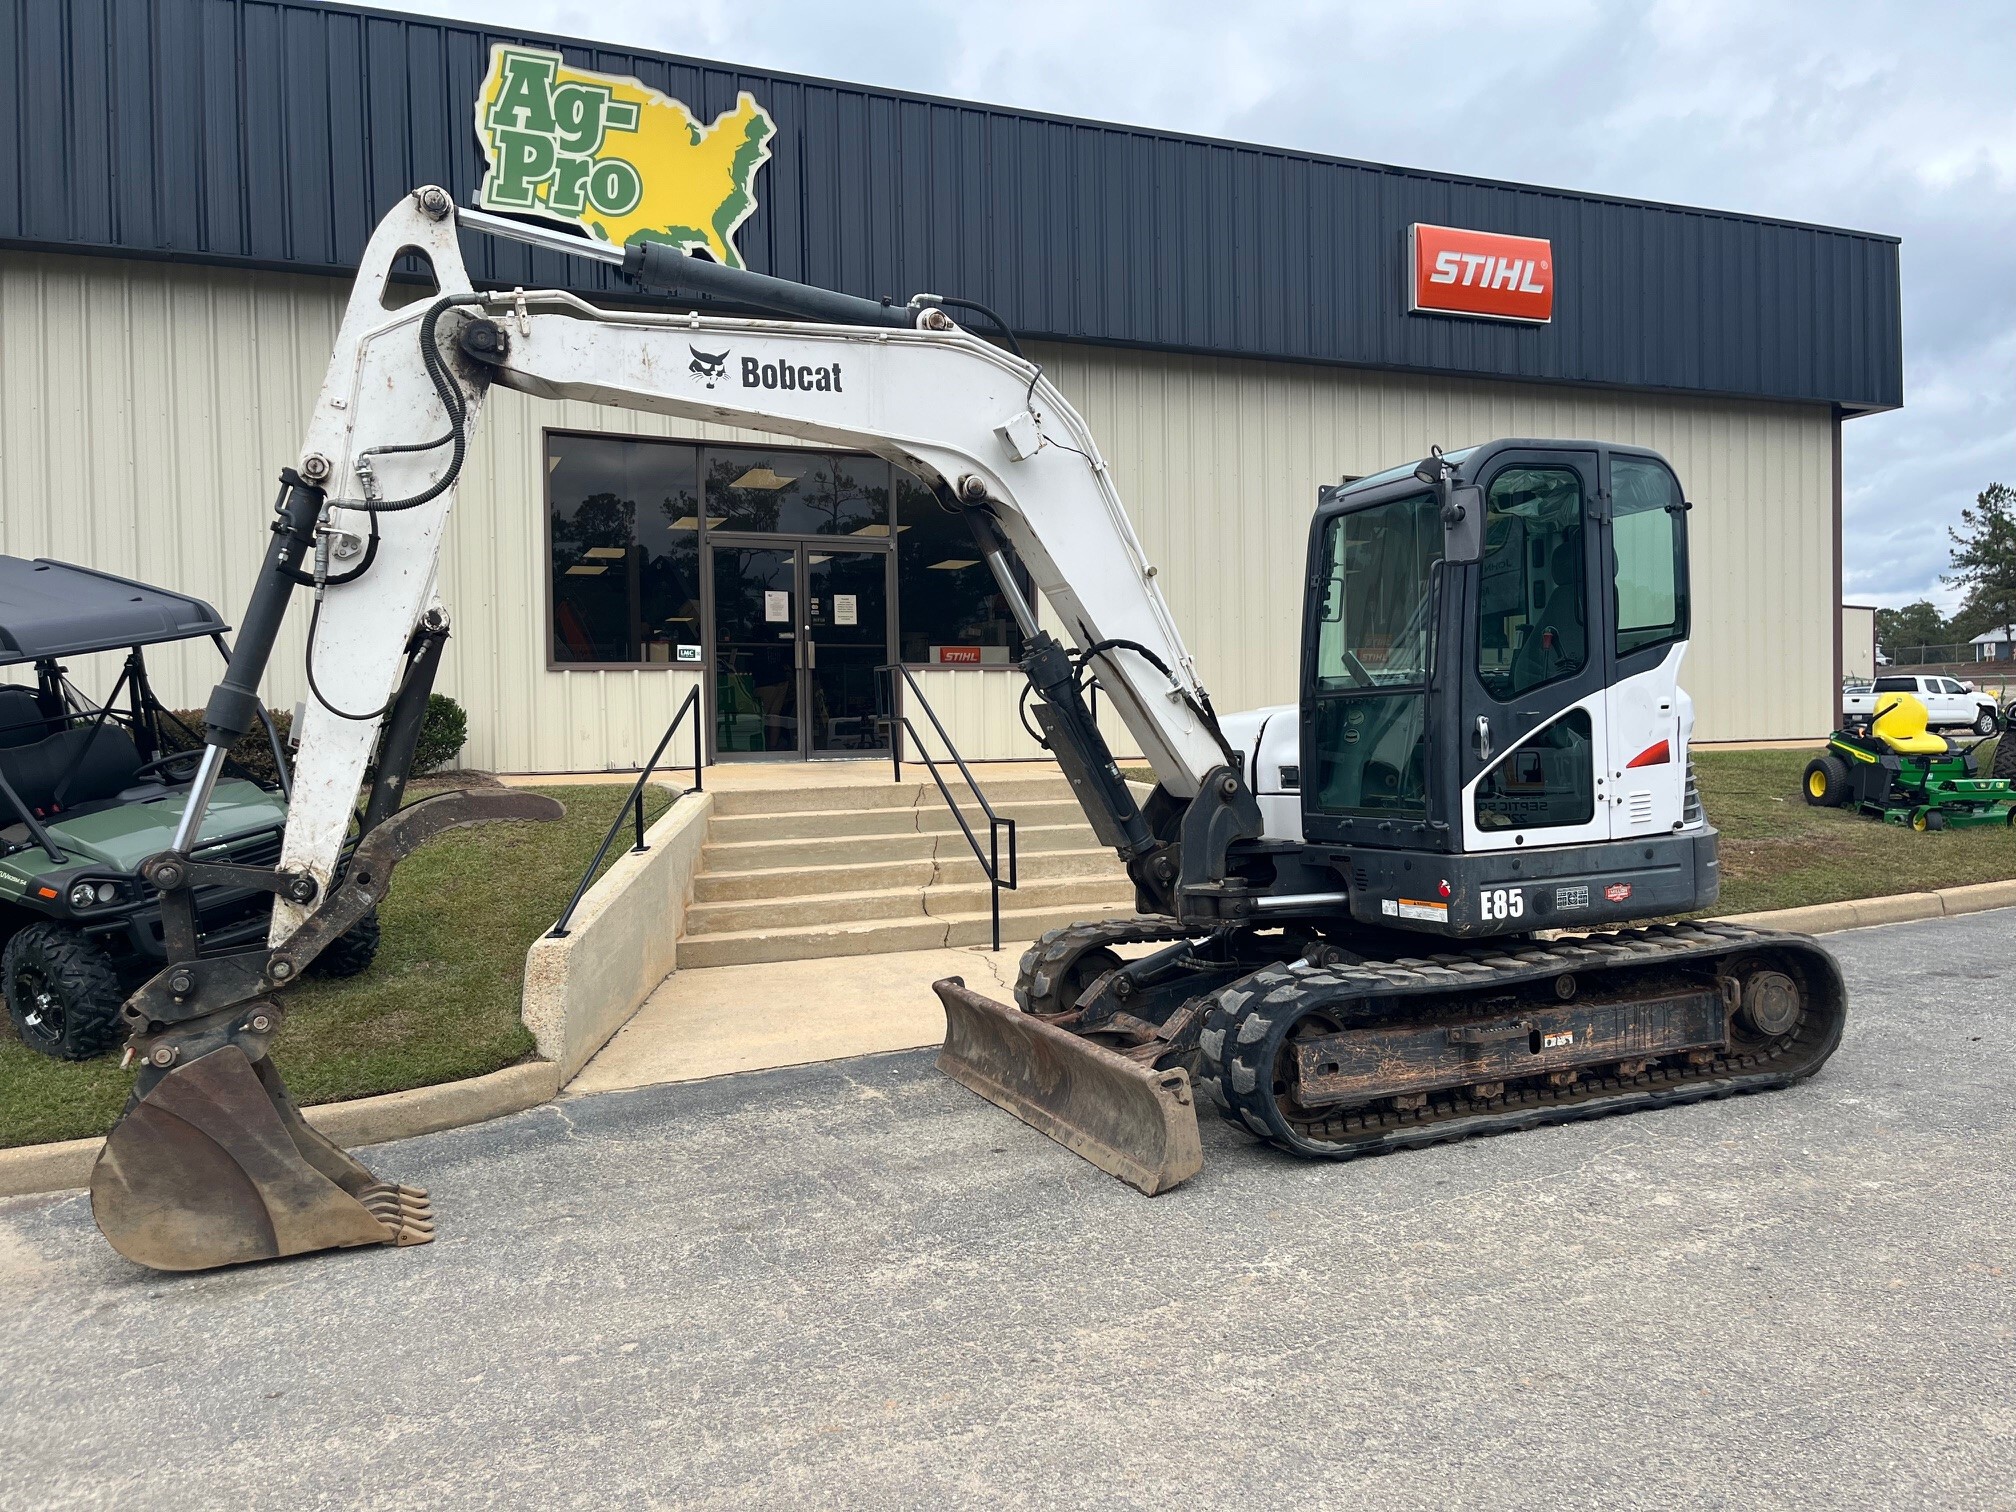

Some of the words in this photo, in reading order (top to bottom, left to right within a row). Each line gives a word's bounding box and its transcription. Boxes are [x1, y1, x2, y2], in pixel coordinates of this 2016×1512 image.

[484, 50, 642, 158] Ag-
[487, 128, 643, 217] Pro
[1430, 250, 1544, 294] STIHL
[741, 356, 843, 393] Bobcat
[944, 652, 978, 662] STIHL
[1480, 888, 1524, 920] E85
